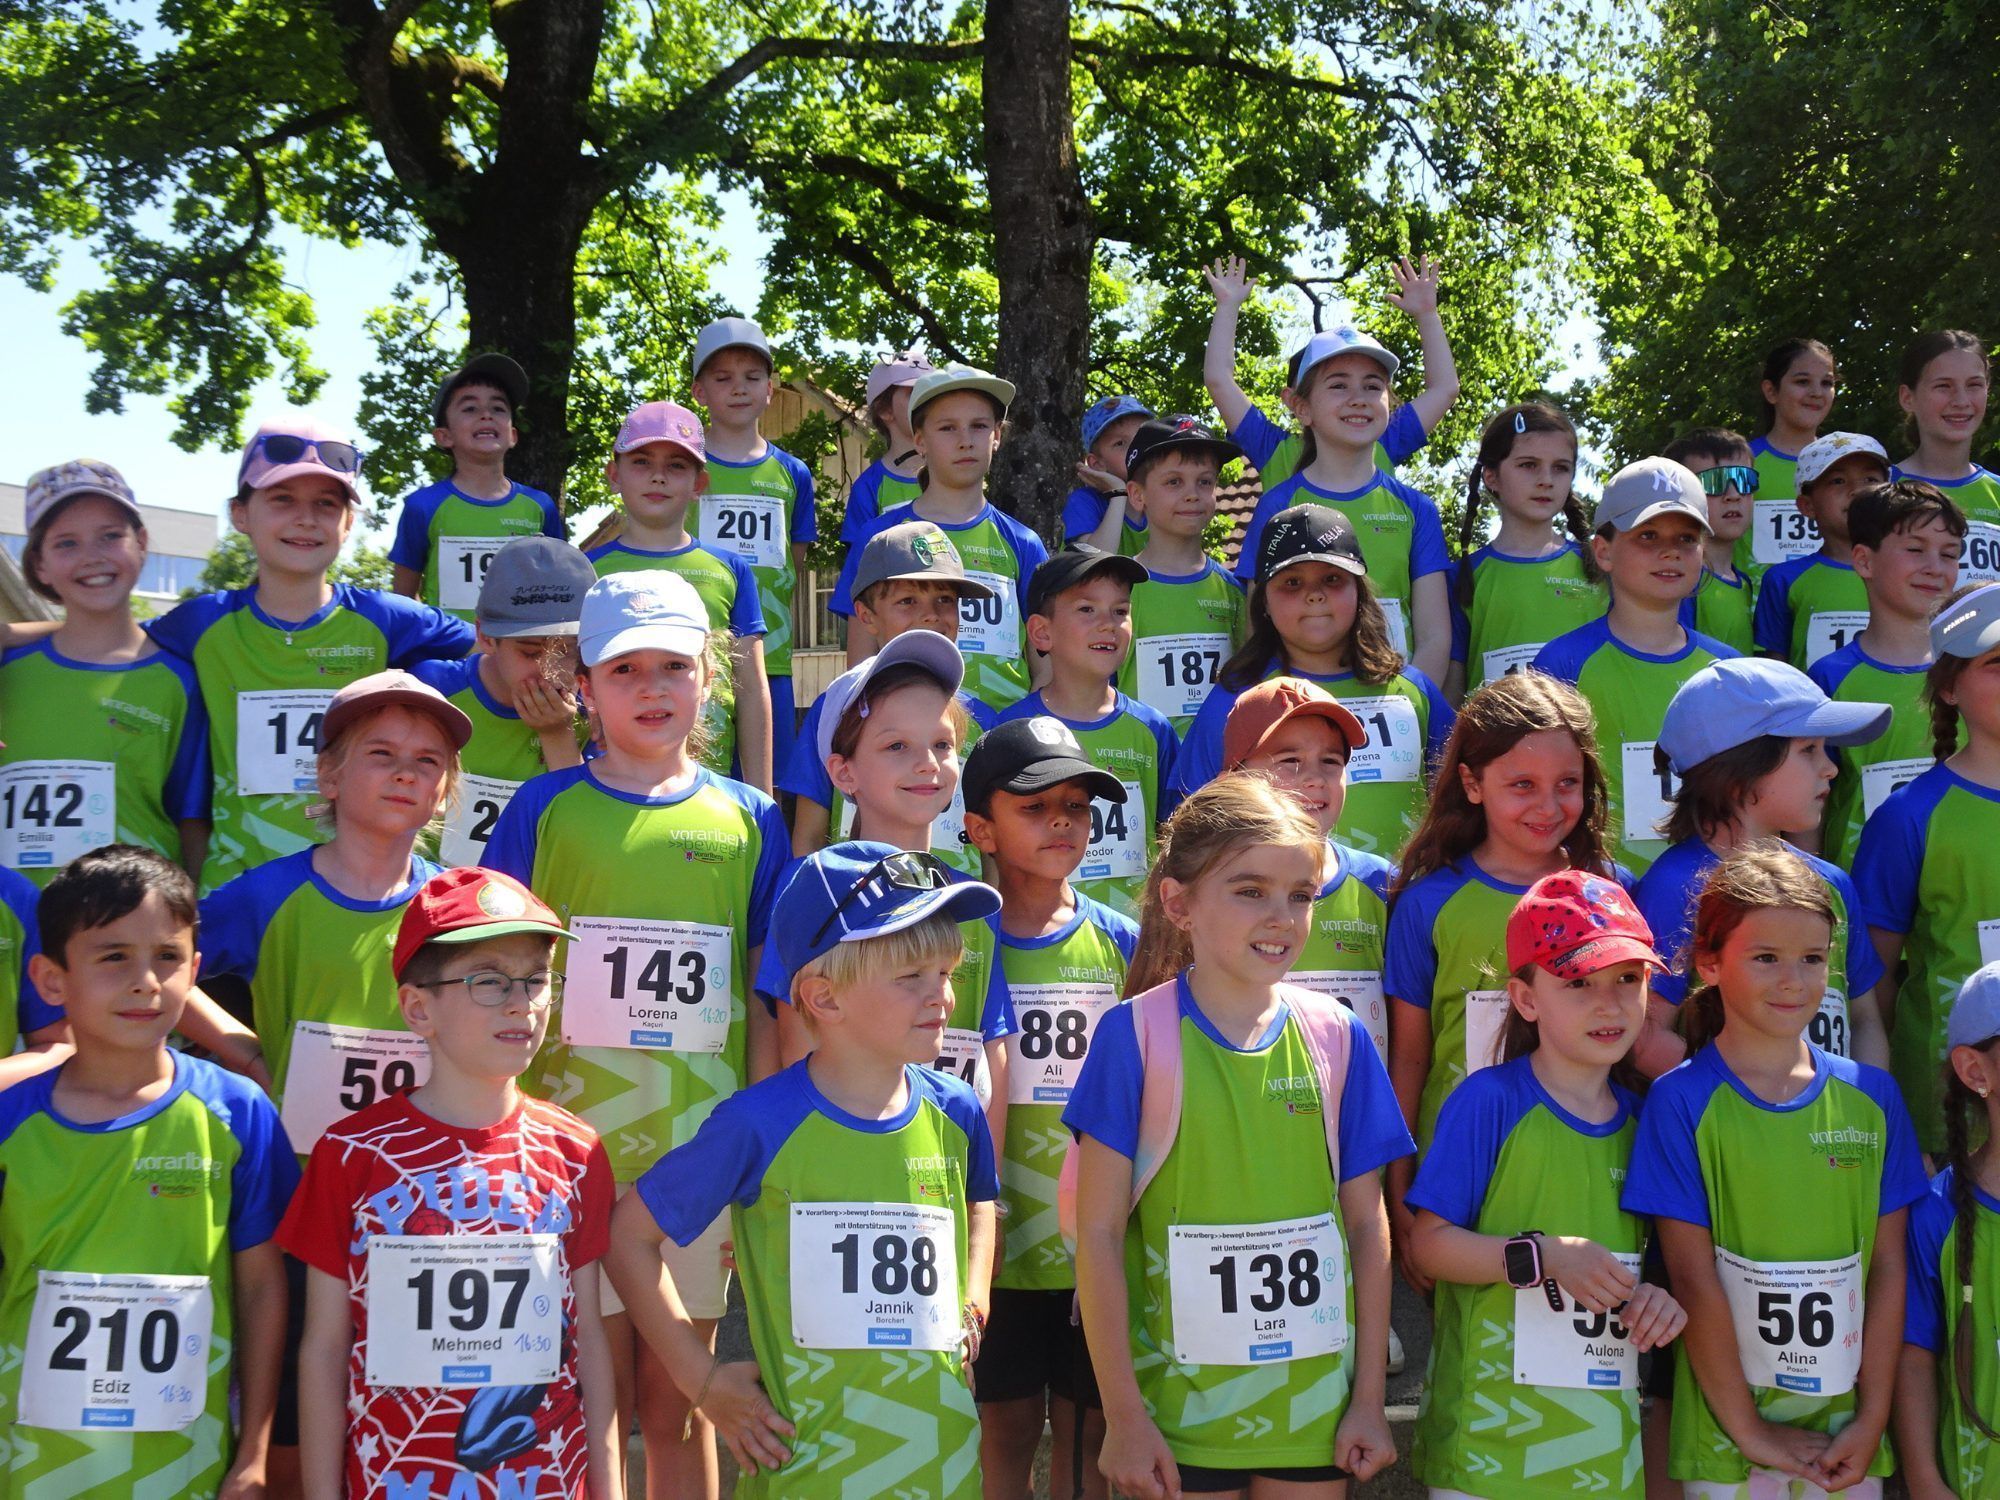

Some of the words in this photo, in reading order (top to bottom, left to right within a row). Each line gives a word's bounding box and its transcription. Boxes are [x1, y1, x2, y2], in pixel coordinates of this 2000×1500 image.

[717, 509, 771, 541] 201
[1770, 514, 1824, 540] 139
[1267, 523, 1292, 556] ITALIA
[1317, 525, 1345, 547] ITALIA
[459, 553, 497, 582] 19
[960, 592, 1003, 625] 50
[958, 625, 985, 634] Emma
[1158, 651, 1220, 686] 187
[268, 712, 324, 755] 14
[295, 758, 318, 769] Pau
[1350, 753, 1381, 764] orena
[4, 783, 84, 829] 142
[1088, 803, 1129, 845] 94
[1086, 847, 1114, 858] eodor
[1320, 918, 1378, 934] vorarlber
[619, 936, 662, 945] Unterstützung
[603, 946, 707, 1005] 143
[629, 1006, 678, 1020] Lorena
[1020, 1009, 1087, 1060] 88
[1808, 1011, 1845, 1057] 93
[1044, 1064, 1062, 1075] Ali
[1809, 1125, 1878, 1149] vorarlberg
[806, 1209, 870, 1217] Vorarlberg>>bewegt
[847, 1222, 894, 1231] Unterstützung
[1183, 1231, 1245, 1239] Vorarlberg>>bewegt
[1246, 1230, 1277, 1238] Dornbirner
[1277, 1227, 1298, 1235] Kinder-
[1211, 1244, 1222, 1252] mit
[1224, 1243, 1270, 1252] Unterstützung
[1272, 1241, 1283, 1249] von
[832, 1234, 938, 1296] 188
[1775, 1268, 1806, 1276] Dornbirner
[1209, 1249, 1321, 1313] 138
[1754, 1280, 1800, 1289] Unterstützung
[407, 1269, 530, 1331] 197
[865, 1300, 914, 1315] Jannik
[876, 1316, 905, 1324] Borchert
[1254, 1318, 1286, 1331] Lara
[1758, 1291, 1834, 1348] 56
[49, 1306, 180, 1374] 210
[1258, 1332, 1284, 1340] Dietrich
[432, 1337, 502, 1351] Mehmed
[1584, 1344, 1624, 1357] Aulona
[1778, 1351, 1817, 1364] Alina
[92, 1379, 131, 1393] Ediz
